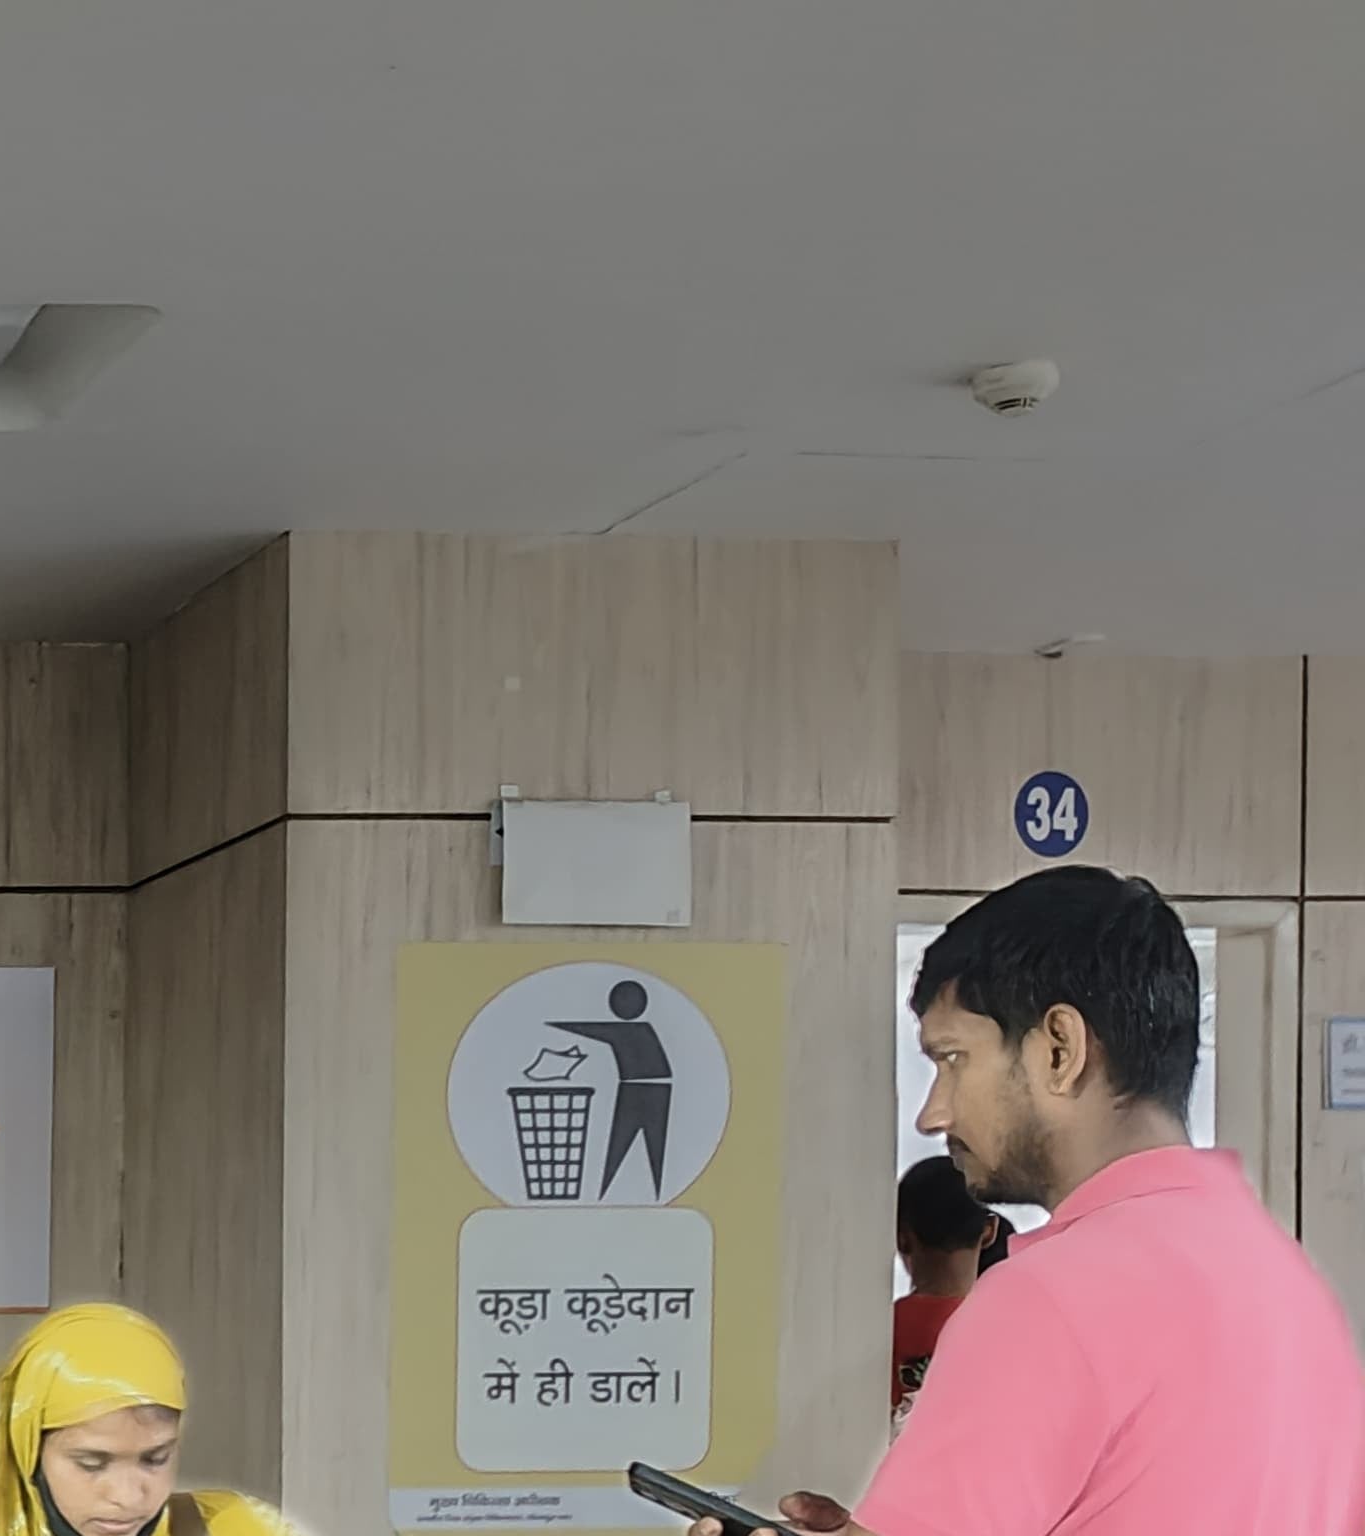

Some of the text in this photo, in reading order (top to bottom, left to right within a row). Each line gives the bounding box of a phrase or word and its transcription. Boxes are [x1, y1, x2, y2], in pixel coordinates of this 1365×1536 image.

[1026, 786, 1078, 842] 34
[476, 1273, 694, 1335] कूड़ा कूड़ेदान
[483, 1358, 519, 1404] में
[534, 1358, 573, 1405] ही
